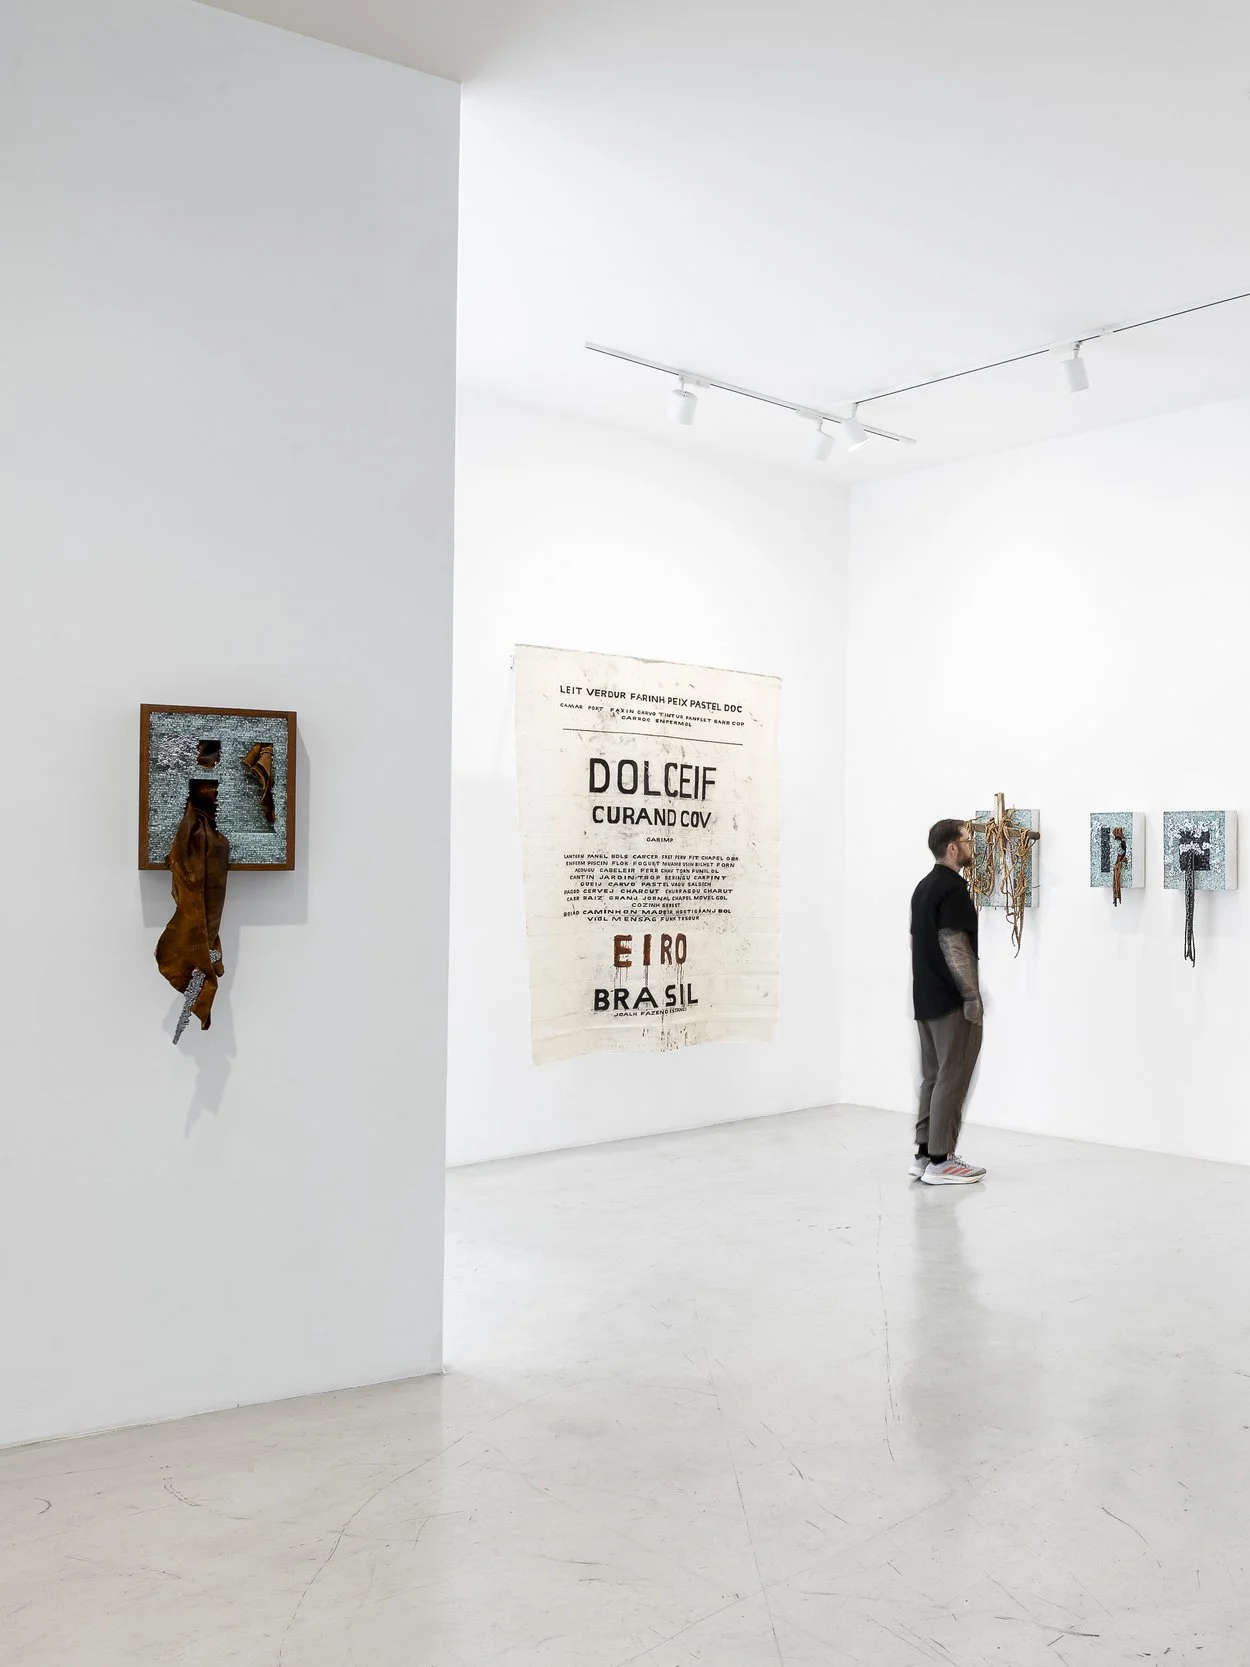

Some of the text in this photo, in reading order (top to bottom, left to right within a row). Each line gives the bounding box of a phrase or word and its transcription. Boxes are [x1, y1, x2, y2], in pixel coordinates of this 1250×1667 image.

[560, 685, 742, 712] LEIT VERDUR FARINH PEIX PASTEL DOC
[592, 806, 712, 828] CURAND COV
[594, 983, 698, 1011] BRASIL
